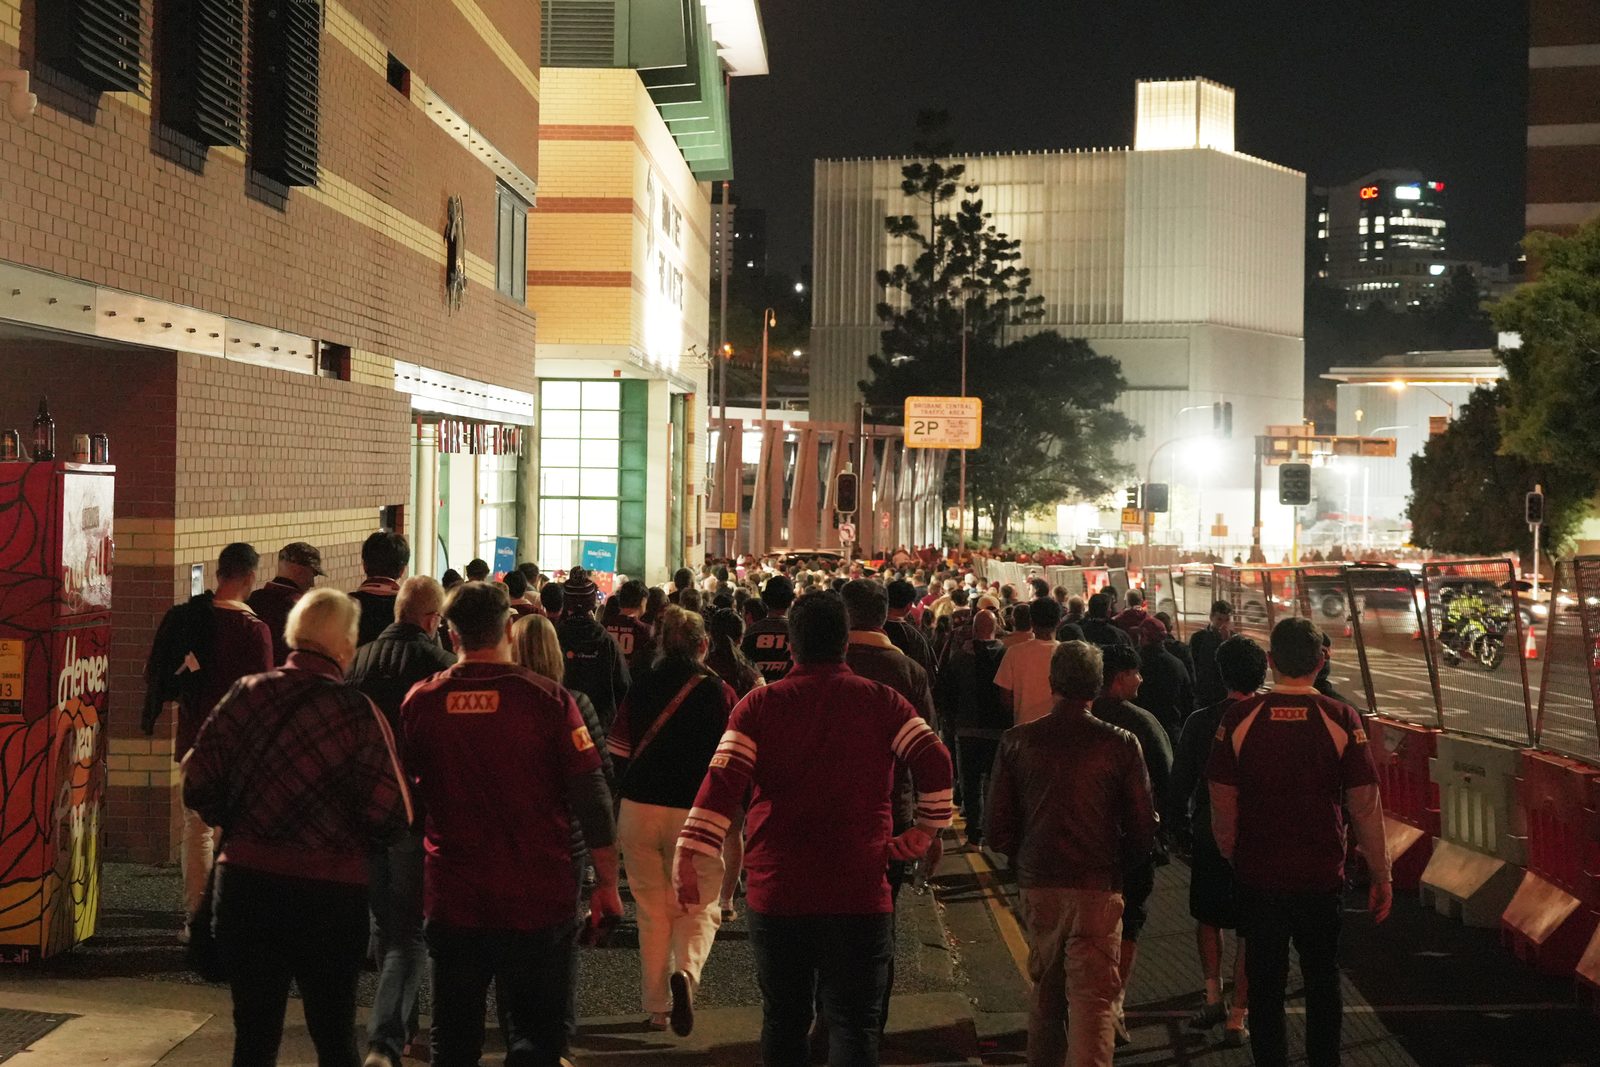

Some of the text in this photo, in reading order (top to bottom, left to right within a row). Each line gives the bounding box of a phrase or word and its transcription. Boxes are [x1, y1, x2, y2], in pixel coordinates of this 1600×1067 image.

[1361, 187, 1378, 199] QIC
[913, 421, 939, 435] 2P
[756, 634, 786, 649] 81
[450, 693, 496, 711] XXXX
[1274, 708, 1307, 720] XXXX
